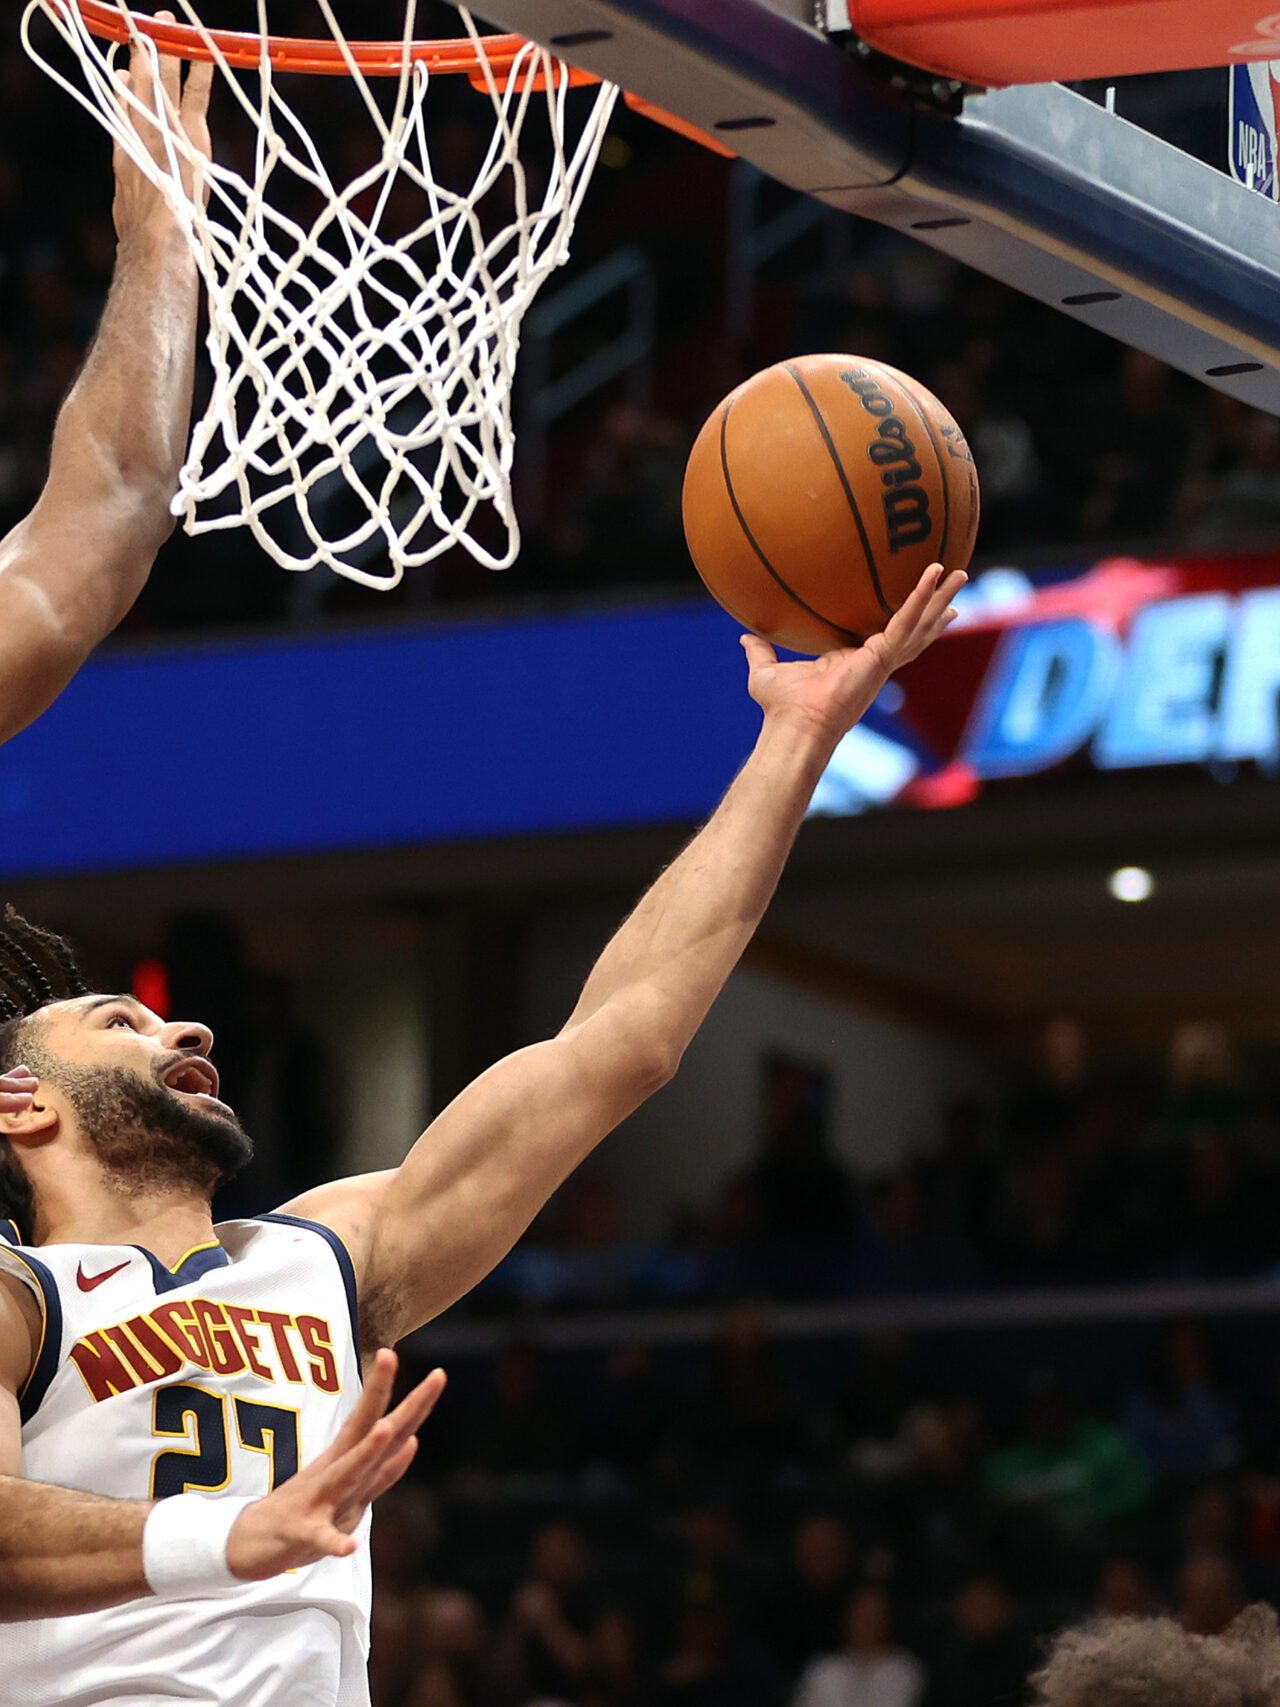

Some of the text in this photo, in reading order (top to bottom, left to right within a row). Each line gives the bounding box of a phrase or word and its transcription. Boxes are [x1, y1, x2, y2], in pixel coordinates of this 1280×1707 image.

[1238, 120, 1267, 181] NBA
[839, 369, 933, 555] Wilson
[69, 1298, 343, 1403] NUGGETS
[151, 1381, 302, 1500] 27
